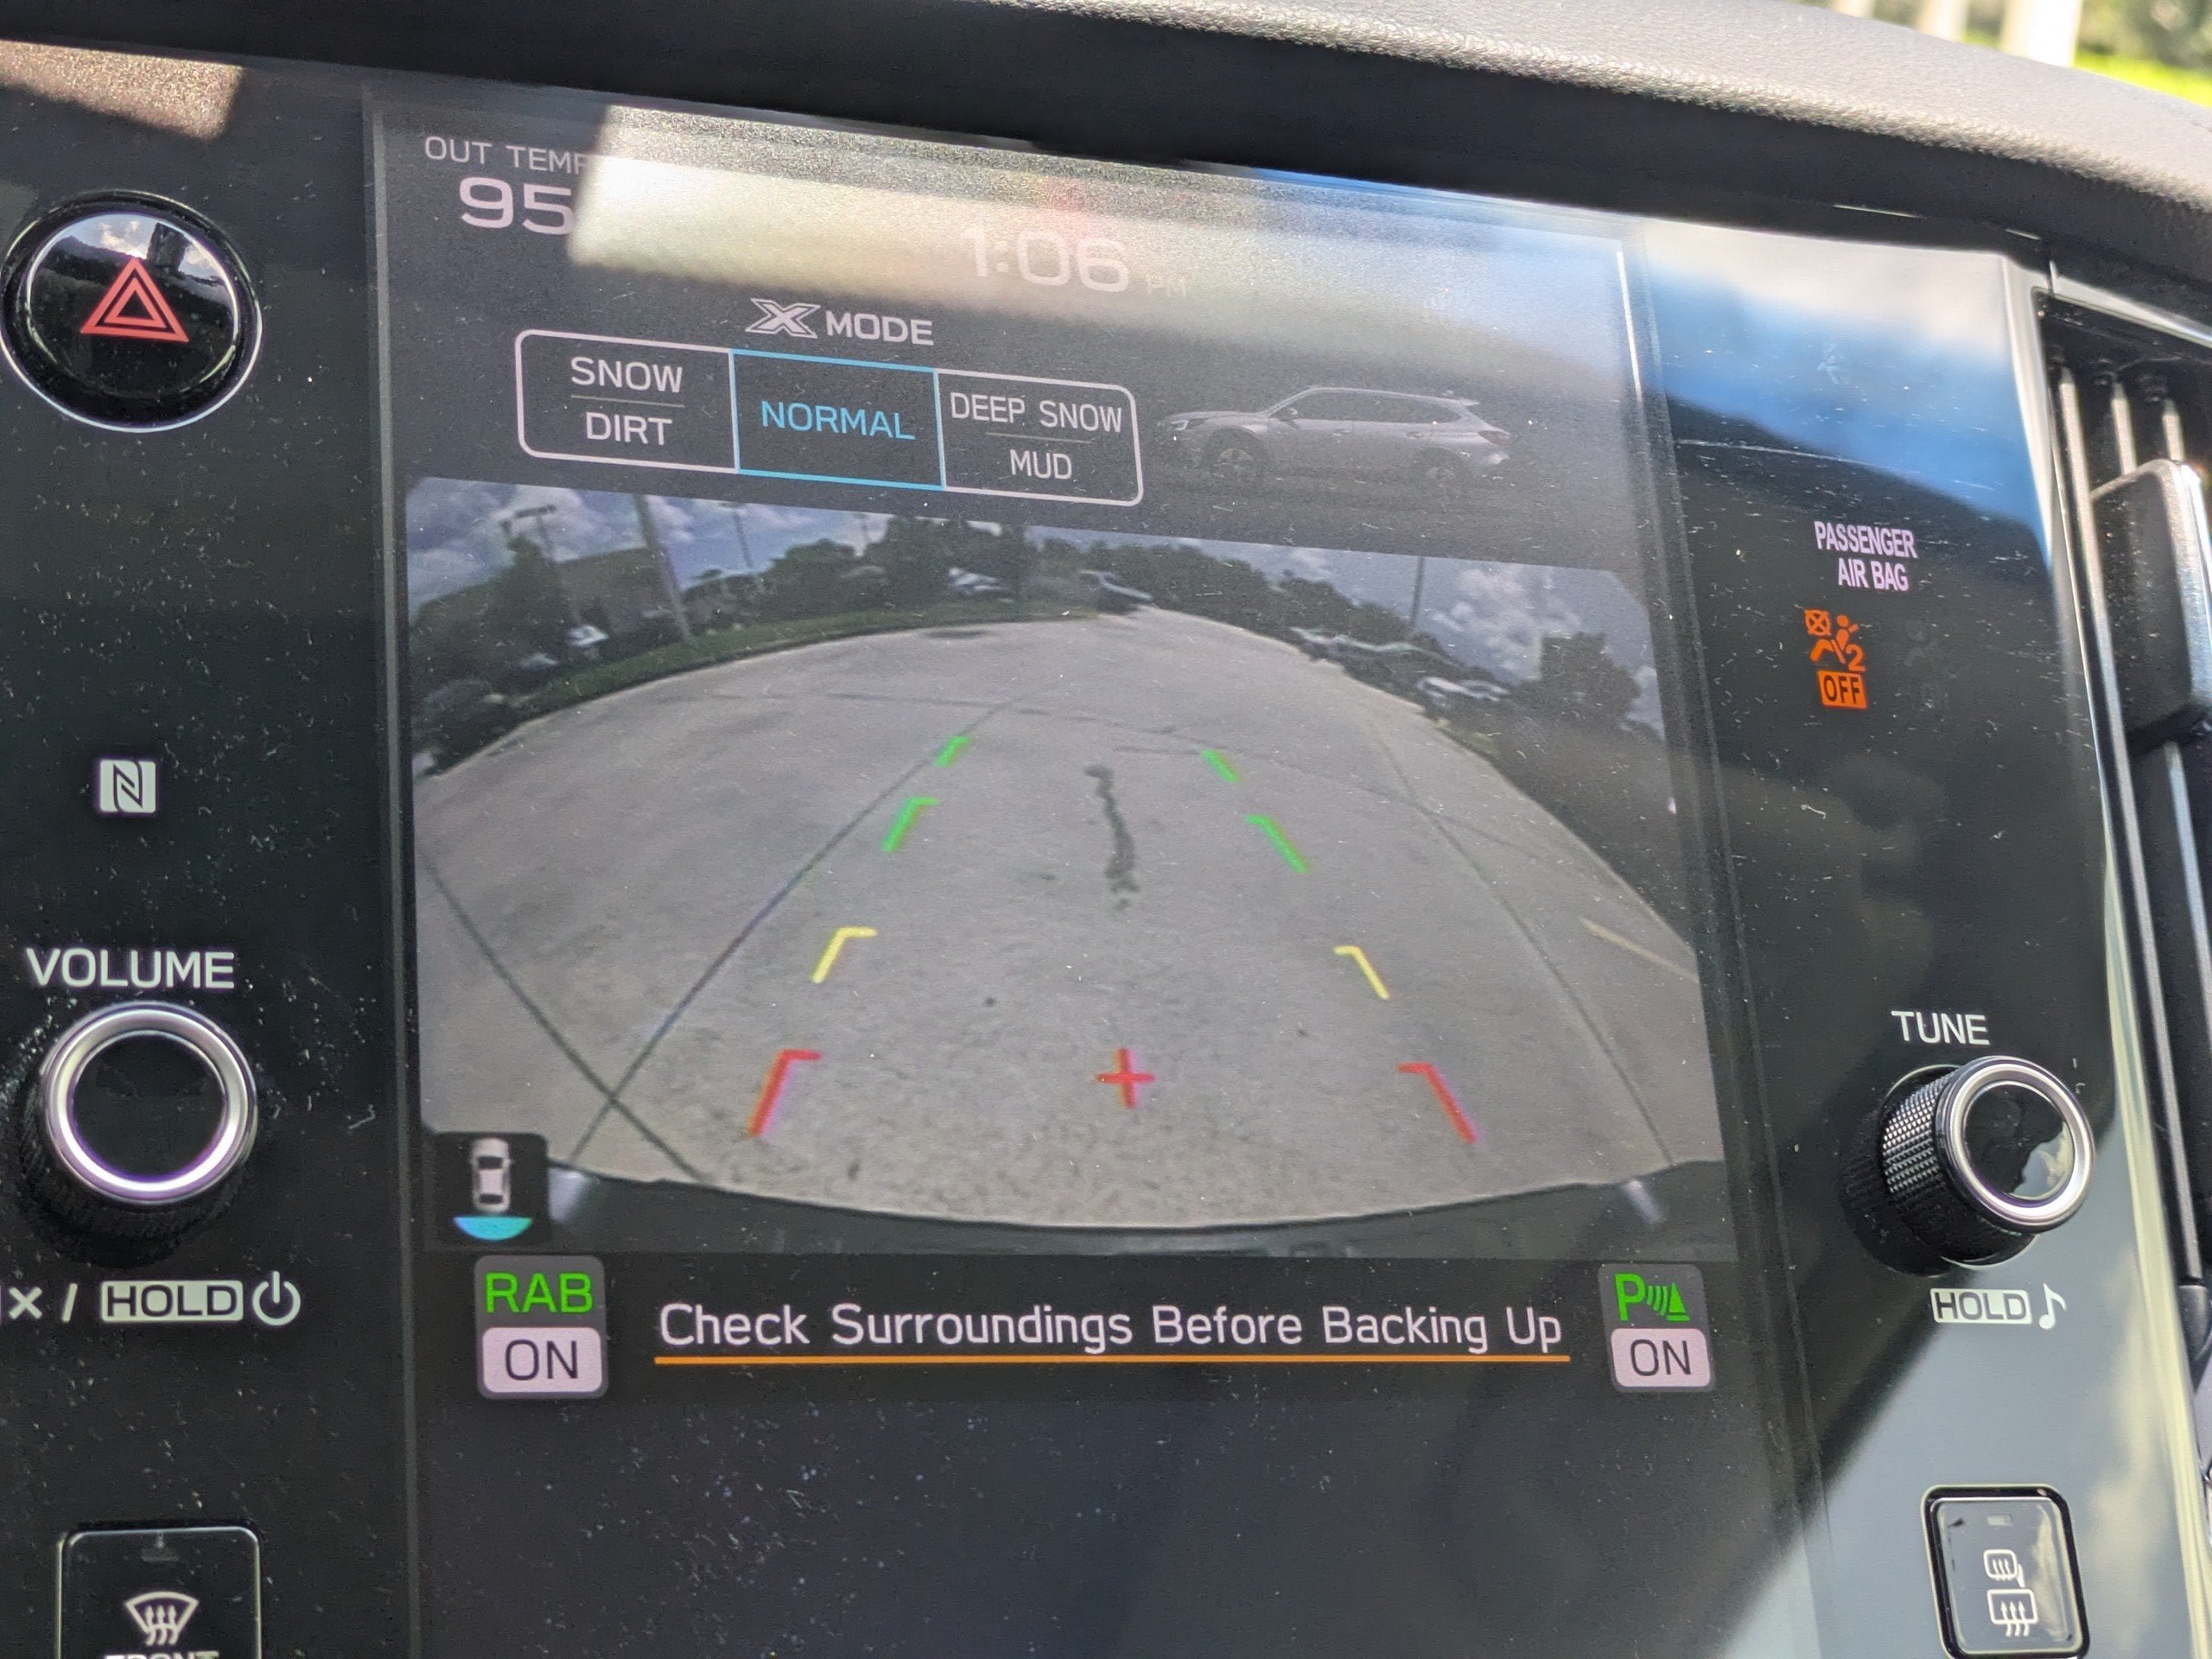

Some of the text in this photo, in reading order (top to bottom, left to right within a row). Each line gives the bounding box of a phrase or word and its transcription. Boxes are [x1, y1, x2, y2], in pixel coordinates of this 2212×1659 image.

[425, 136, 493, 164] OUT
[460, 176, 576, 235] 95
[958, 226, 1128, 293] 1:06
[825, 309, 934, 346] MODE
[570, 356, 683, 394] SNOW
[586, 411, 672, 446] DIRT
[760, 400, 916, 441] NORMAL
[950, 391, 1122, 433] DEEP SNOW
[1009, 449, 1072, 480] MUD
[1814, 520, 1917, 559] PASSENGER
[1837, 557, 1909, 591] AIR BAG
[1822, 675, 1861, 704] OFF
[26, 947, 235, 988] VOLUME
[1891, 1010, 1990, 1046] TUNE
[105, 1284, 238, 1318] HOLD
[485, 1271, 594, 1313] RAB
[1935, 1291, 2028, 1321] HOLD
[660, 1302, 1561, 1355] Check Surroundings Before Backing Up
[505, 1339, 579, 1381] ON
[1629, 1338, 1692, 1376] ON
